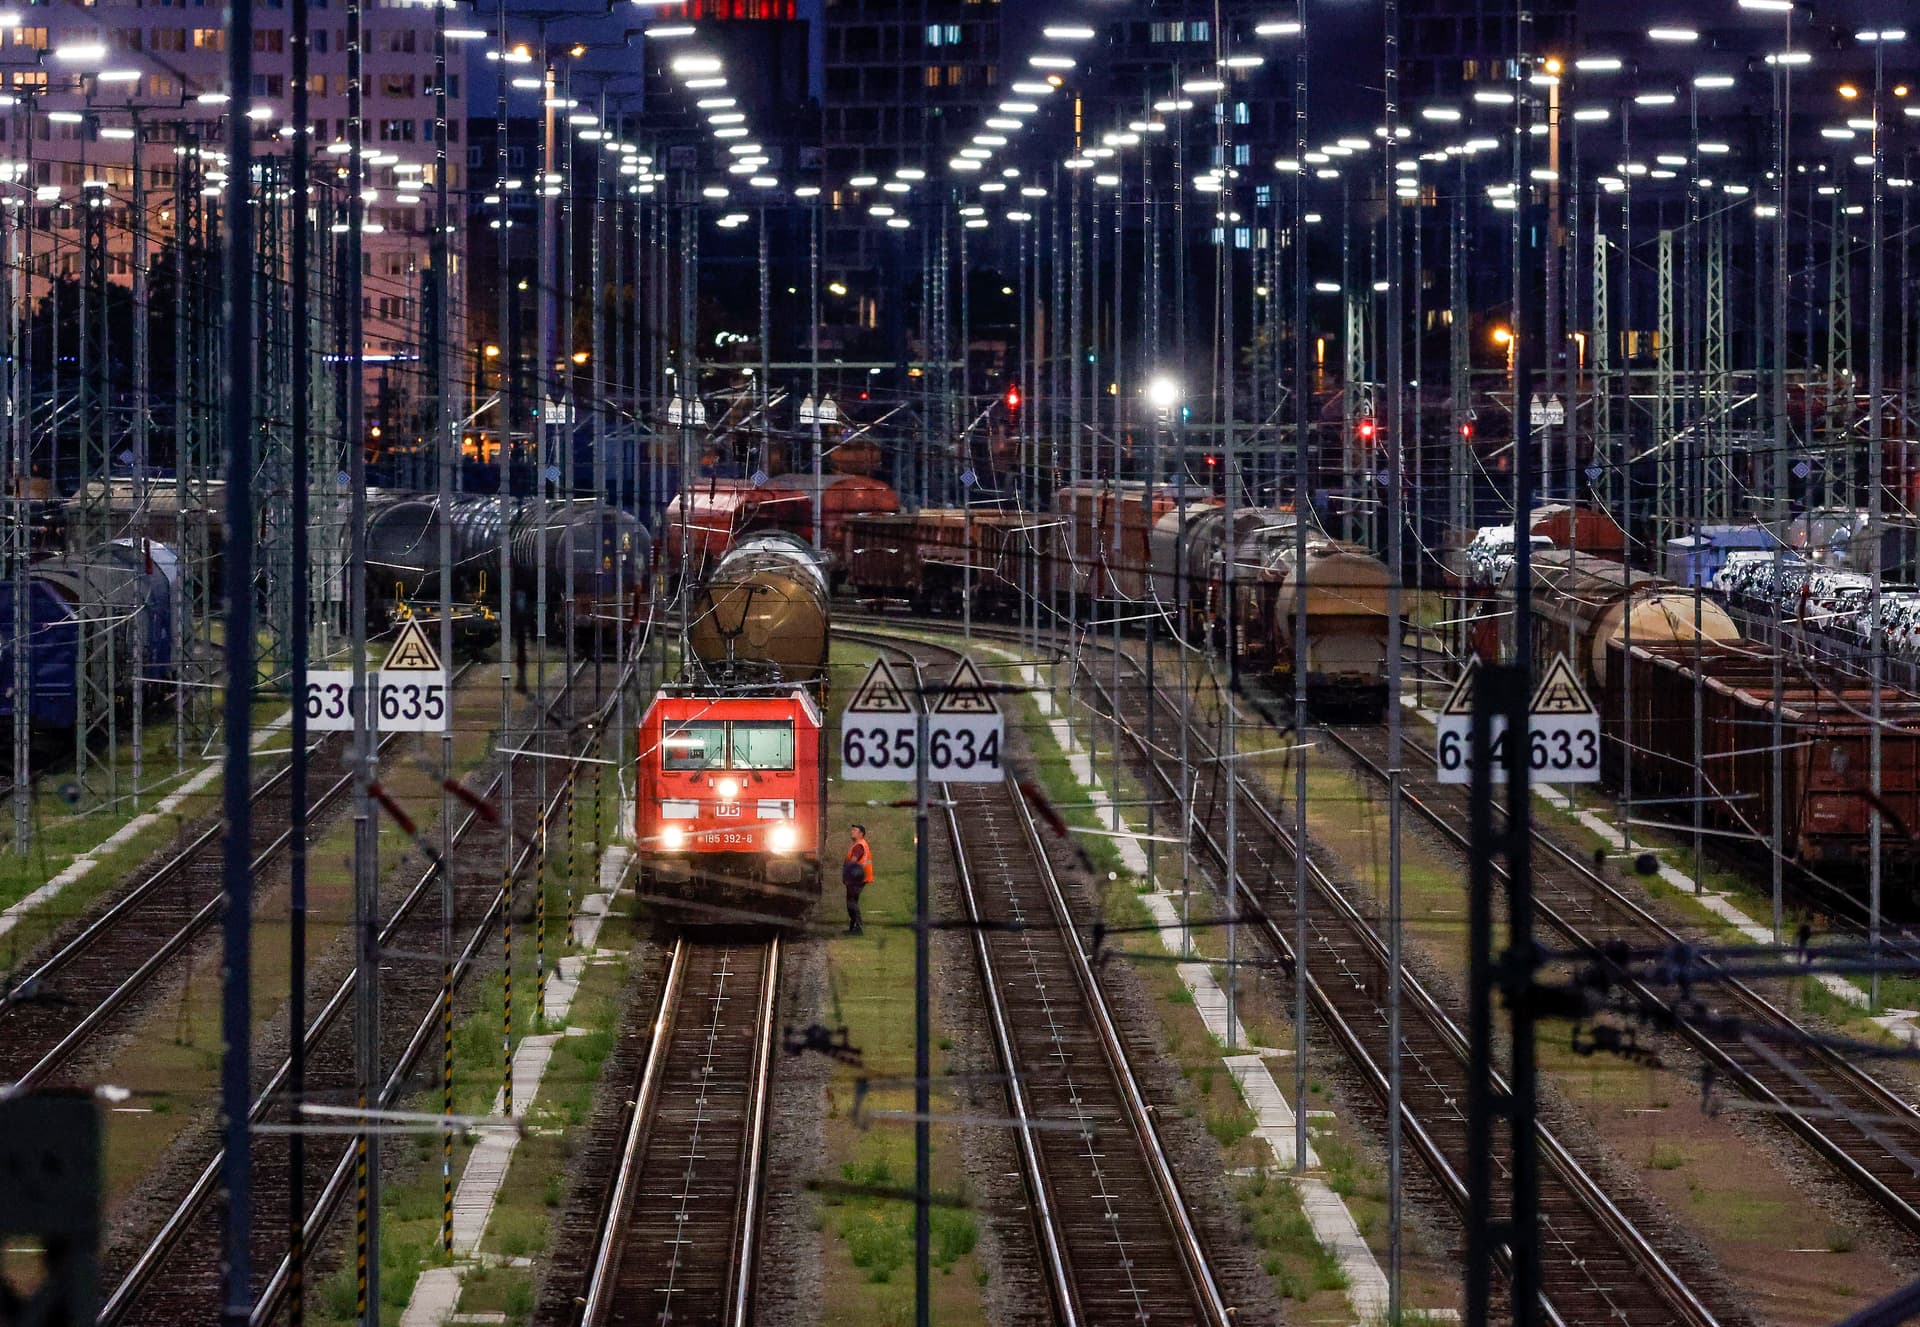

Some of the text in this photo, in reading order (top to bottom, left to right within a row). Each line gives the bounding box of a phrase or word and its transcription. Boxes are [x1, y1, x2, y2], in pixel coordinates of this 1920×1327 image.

[305, 683, 355, 719] 63
[380, 684, 444, 720] 635
[843, 728, 915, 768] 635
[930, 729, 999, 769] 634
[1528, 729, 1598, 769] 633
[717, 802, 740, 816] DB
[705, 834, 753, 843] 185 392-8
